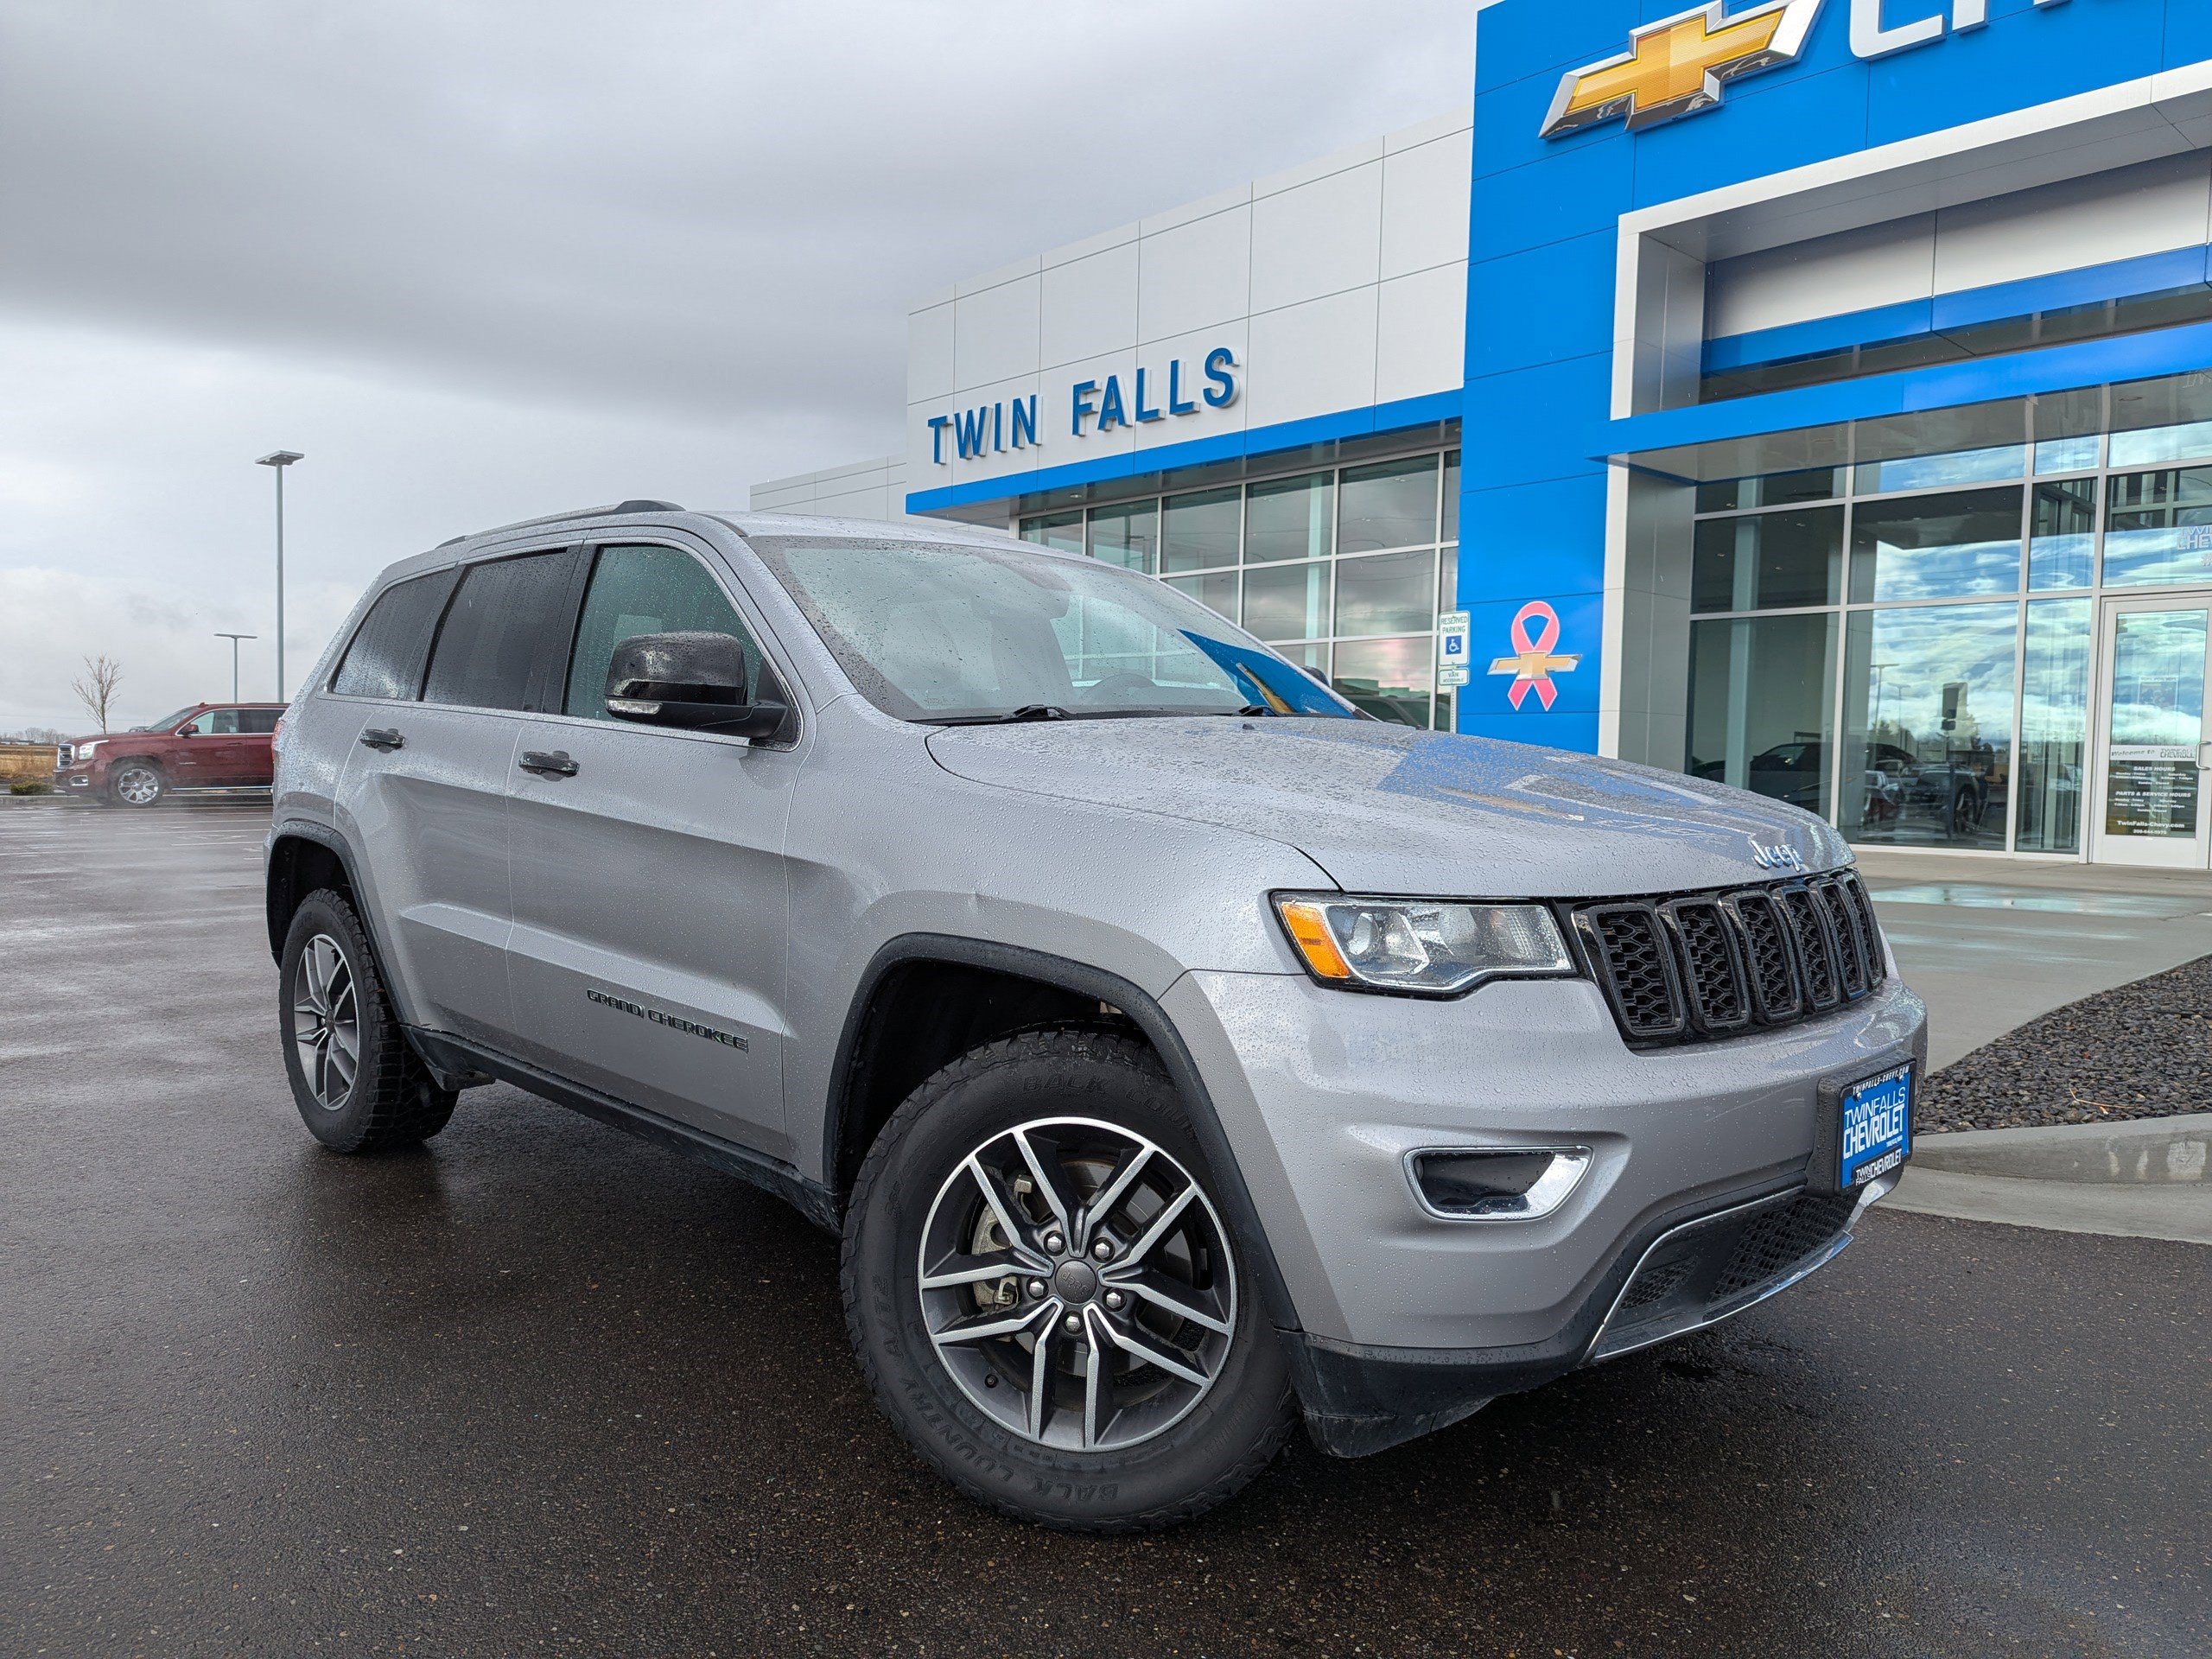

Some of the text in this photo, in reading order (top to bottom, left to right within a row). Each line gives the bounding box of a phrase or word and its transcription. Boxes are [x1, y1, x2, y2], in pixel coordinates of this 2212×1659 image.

[927, 347, 1240, 466] TWIN FALLS
[1441, 616, 1467, 625] RESERVED
[1442, 626, 1466, 634] PARKING
[2117, 820, 2184, 829] TwinFalls-Chevy.com
[1750, 840, 1803, 873] Jeep
[587, 988, 749, 1052] GRAND CHEROKEE
[1023, 1075, 1107, 1095] BACK
[1845, 1086, 1906, 1128] TWINFALLS
[1843, 1103, 1905, 1160] CHEVROLET
[1856, 1166, 1872, 1178] TWIN
[1871, 1148, 1902, 1179] CHEVROLET
[1856, 1172, 1871, 1186] FALLS
[1033, 1476, 1120, 1503] BACK
